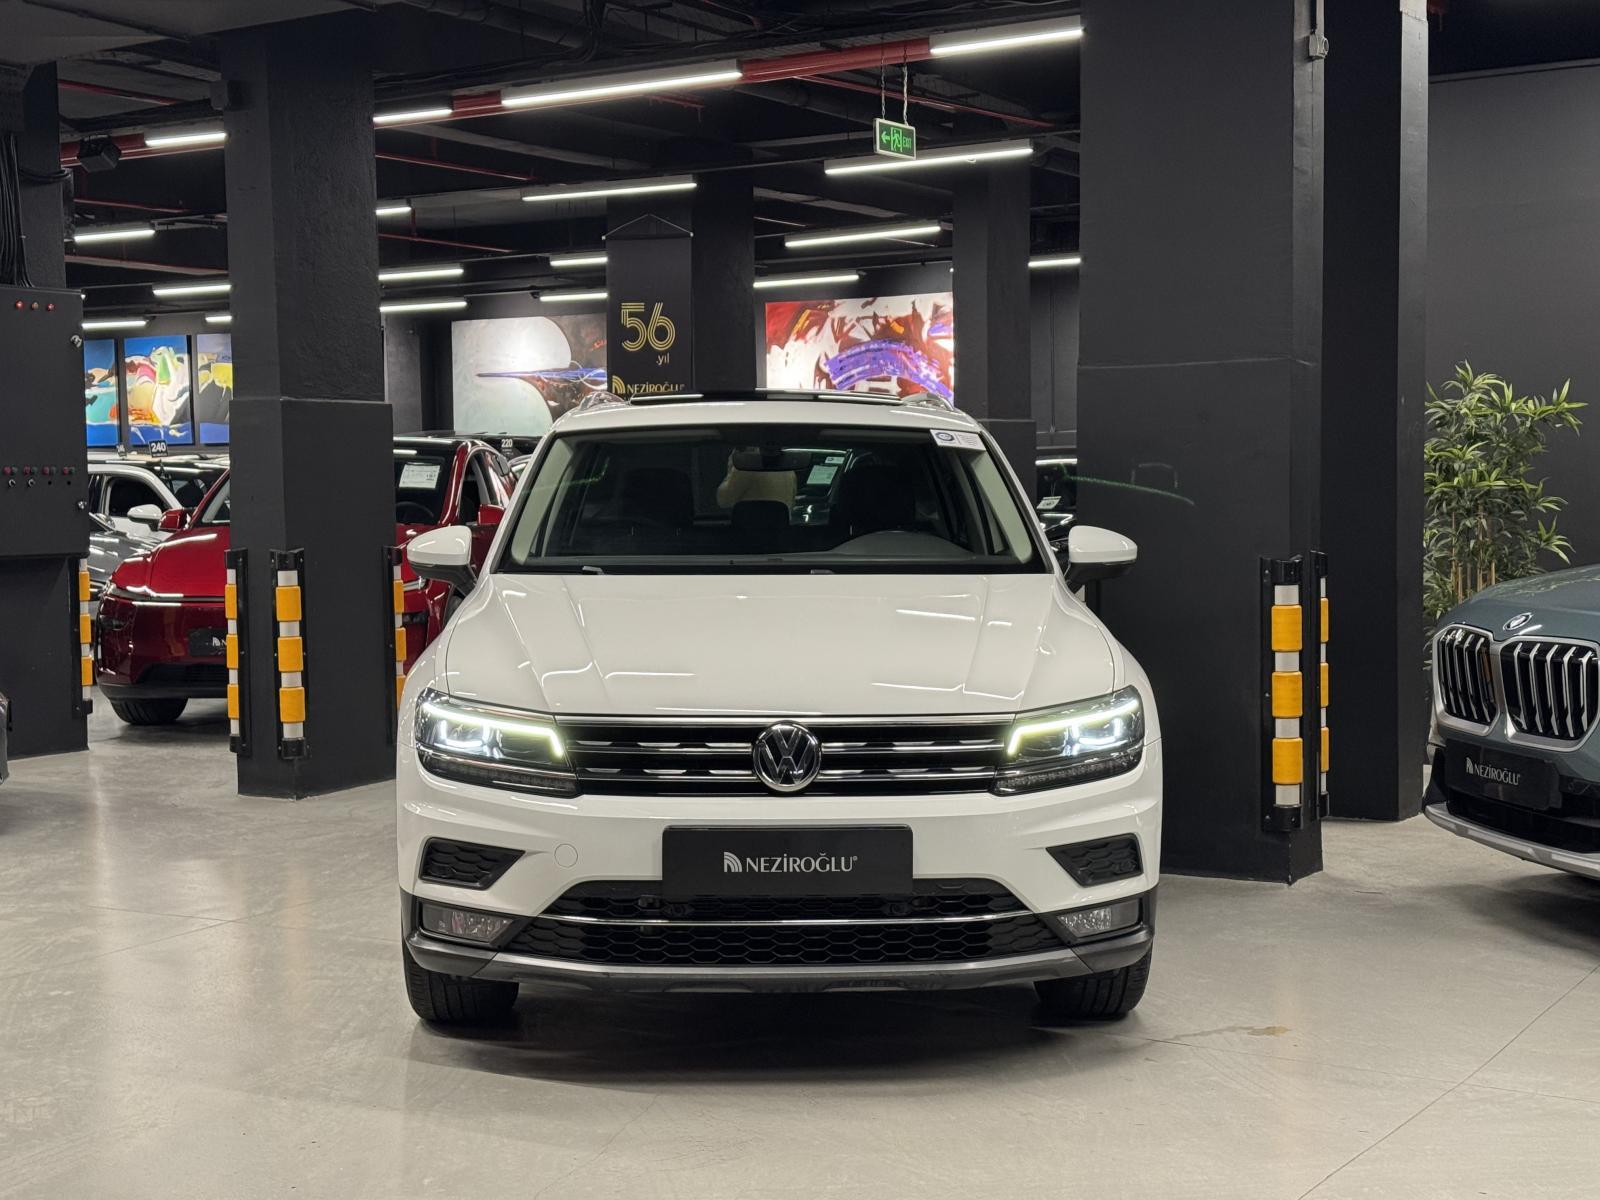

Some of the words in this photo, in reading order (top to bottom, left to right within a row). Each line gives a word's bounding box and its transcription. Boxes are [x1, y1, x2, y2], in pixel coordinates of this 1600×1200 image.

[621, 302, 675, 351] 56
[151, 442, 167, 452] 240
[501, 438, 513, 448] 220
[1474, 764, 1519, 785] NEZİROĞLU
[746, 853, 853, 873] NEZİROĞLU
